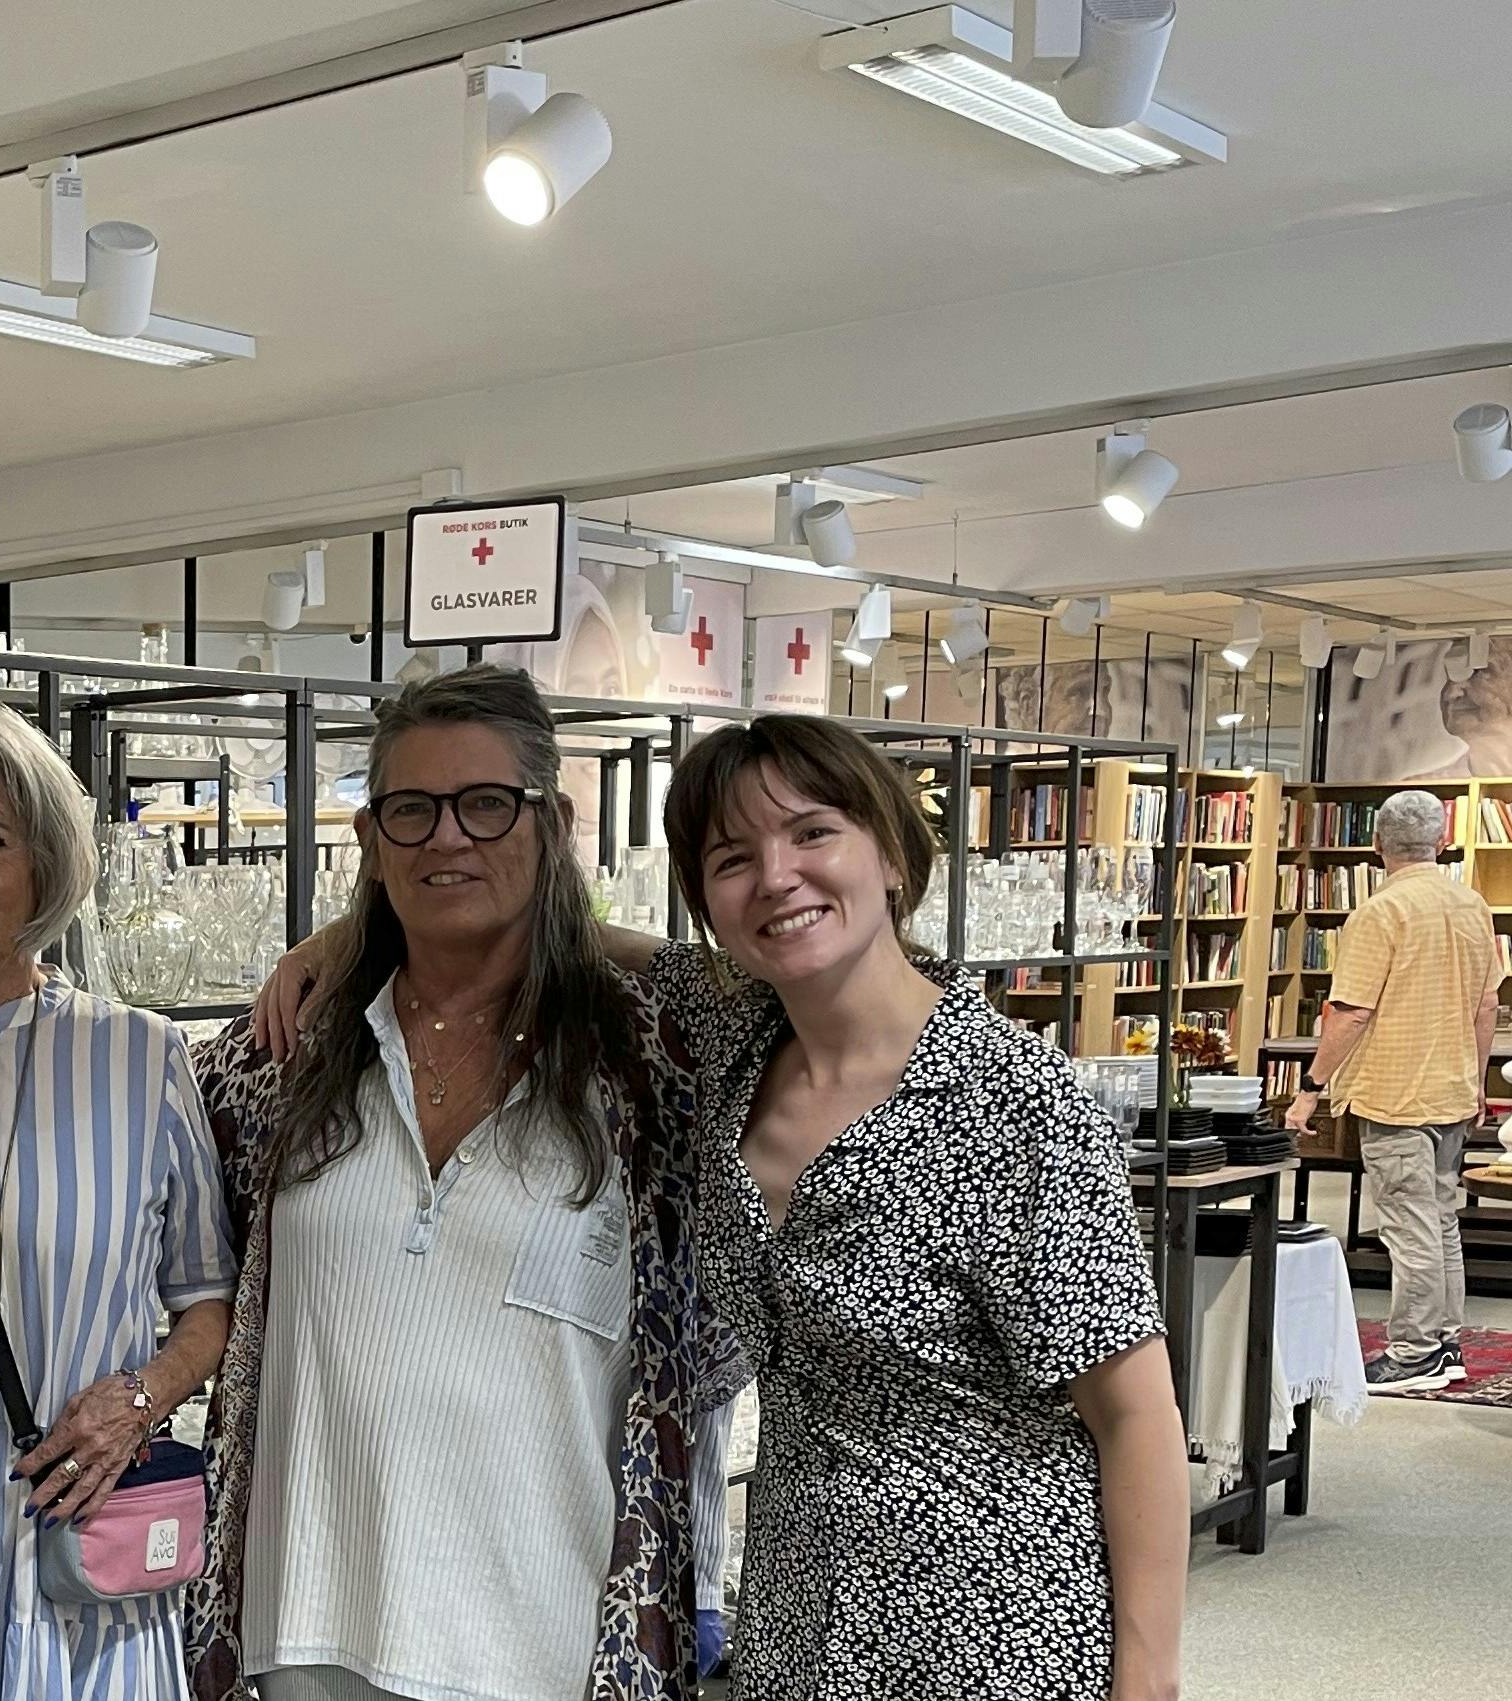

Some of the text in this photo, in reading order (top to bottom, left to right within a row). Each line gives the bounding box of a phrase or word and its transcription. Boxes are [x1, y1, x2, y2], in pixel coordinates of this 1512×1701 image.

[442, 518, 529, 534] RØDE KORS BUTIK
[431, 588, 537, 611] GLASVARER
